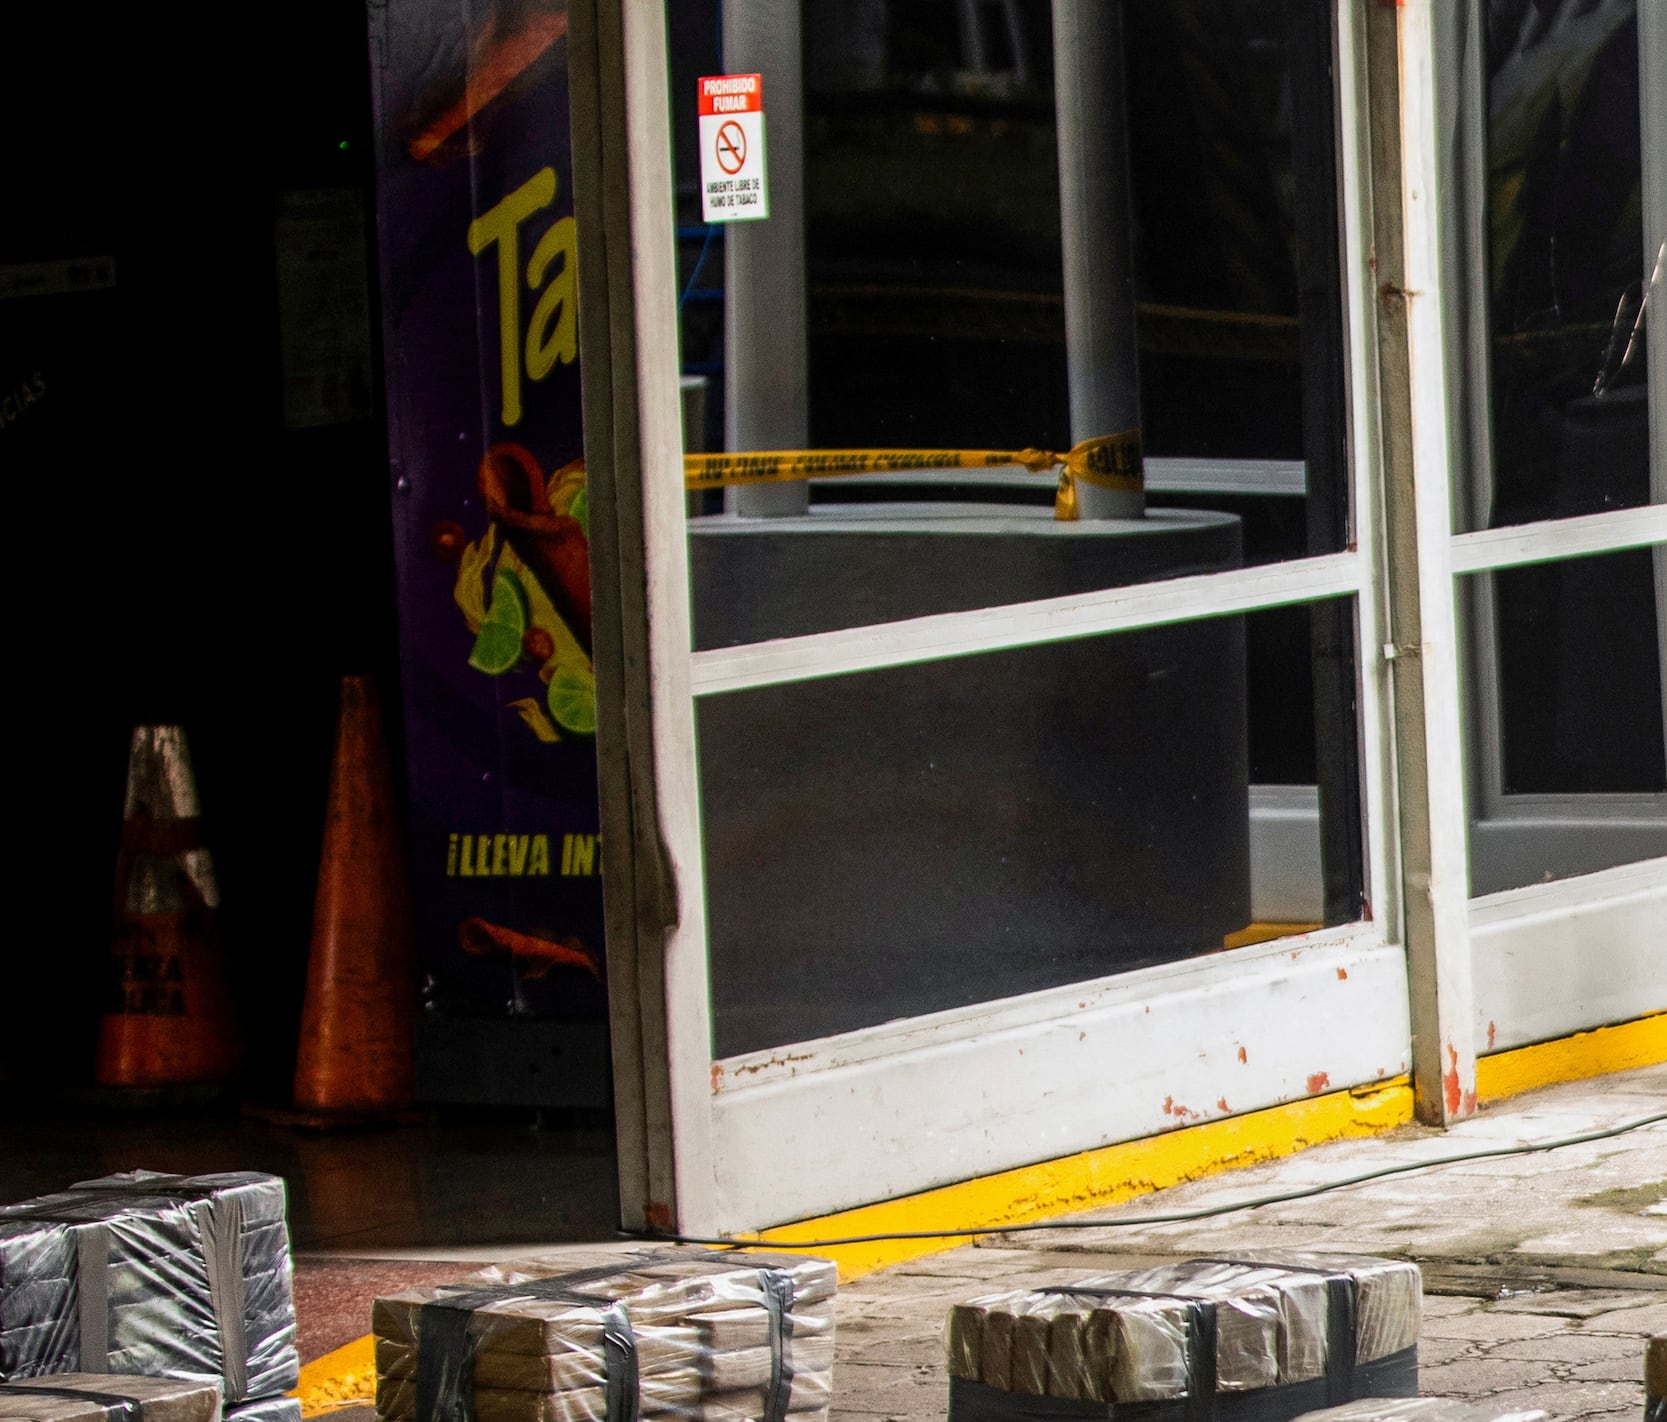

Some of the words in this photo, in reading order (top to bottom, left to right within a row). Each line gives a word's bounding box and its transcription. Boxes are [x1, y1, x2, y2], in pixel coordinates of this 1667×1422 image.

[704, 77, 755, 95] PROHIBIDO
[713, 95, 746, 112] FUMAR
[707, 180, 734, 194] AMBIENTE
[735, 179, 751, 191] LIBRE
[753, 178, 760, 190] DE
[561, 833, 603, 876] IN
